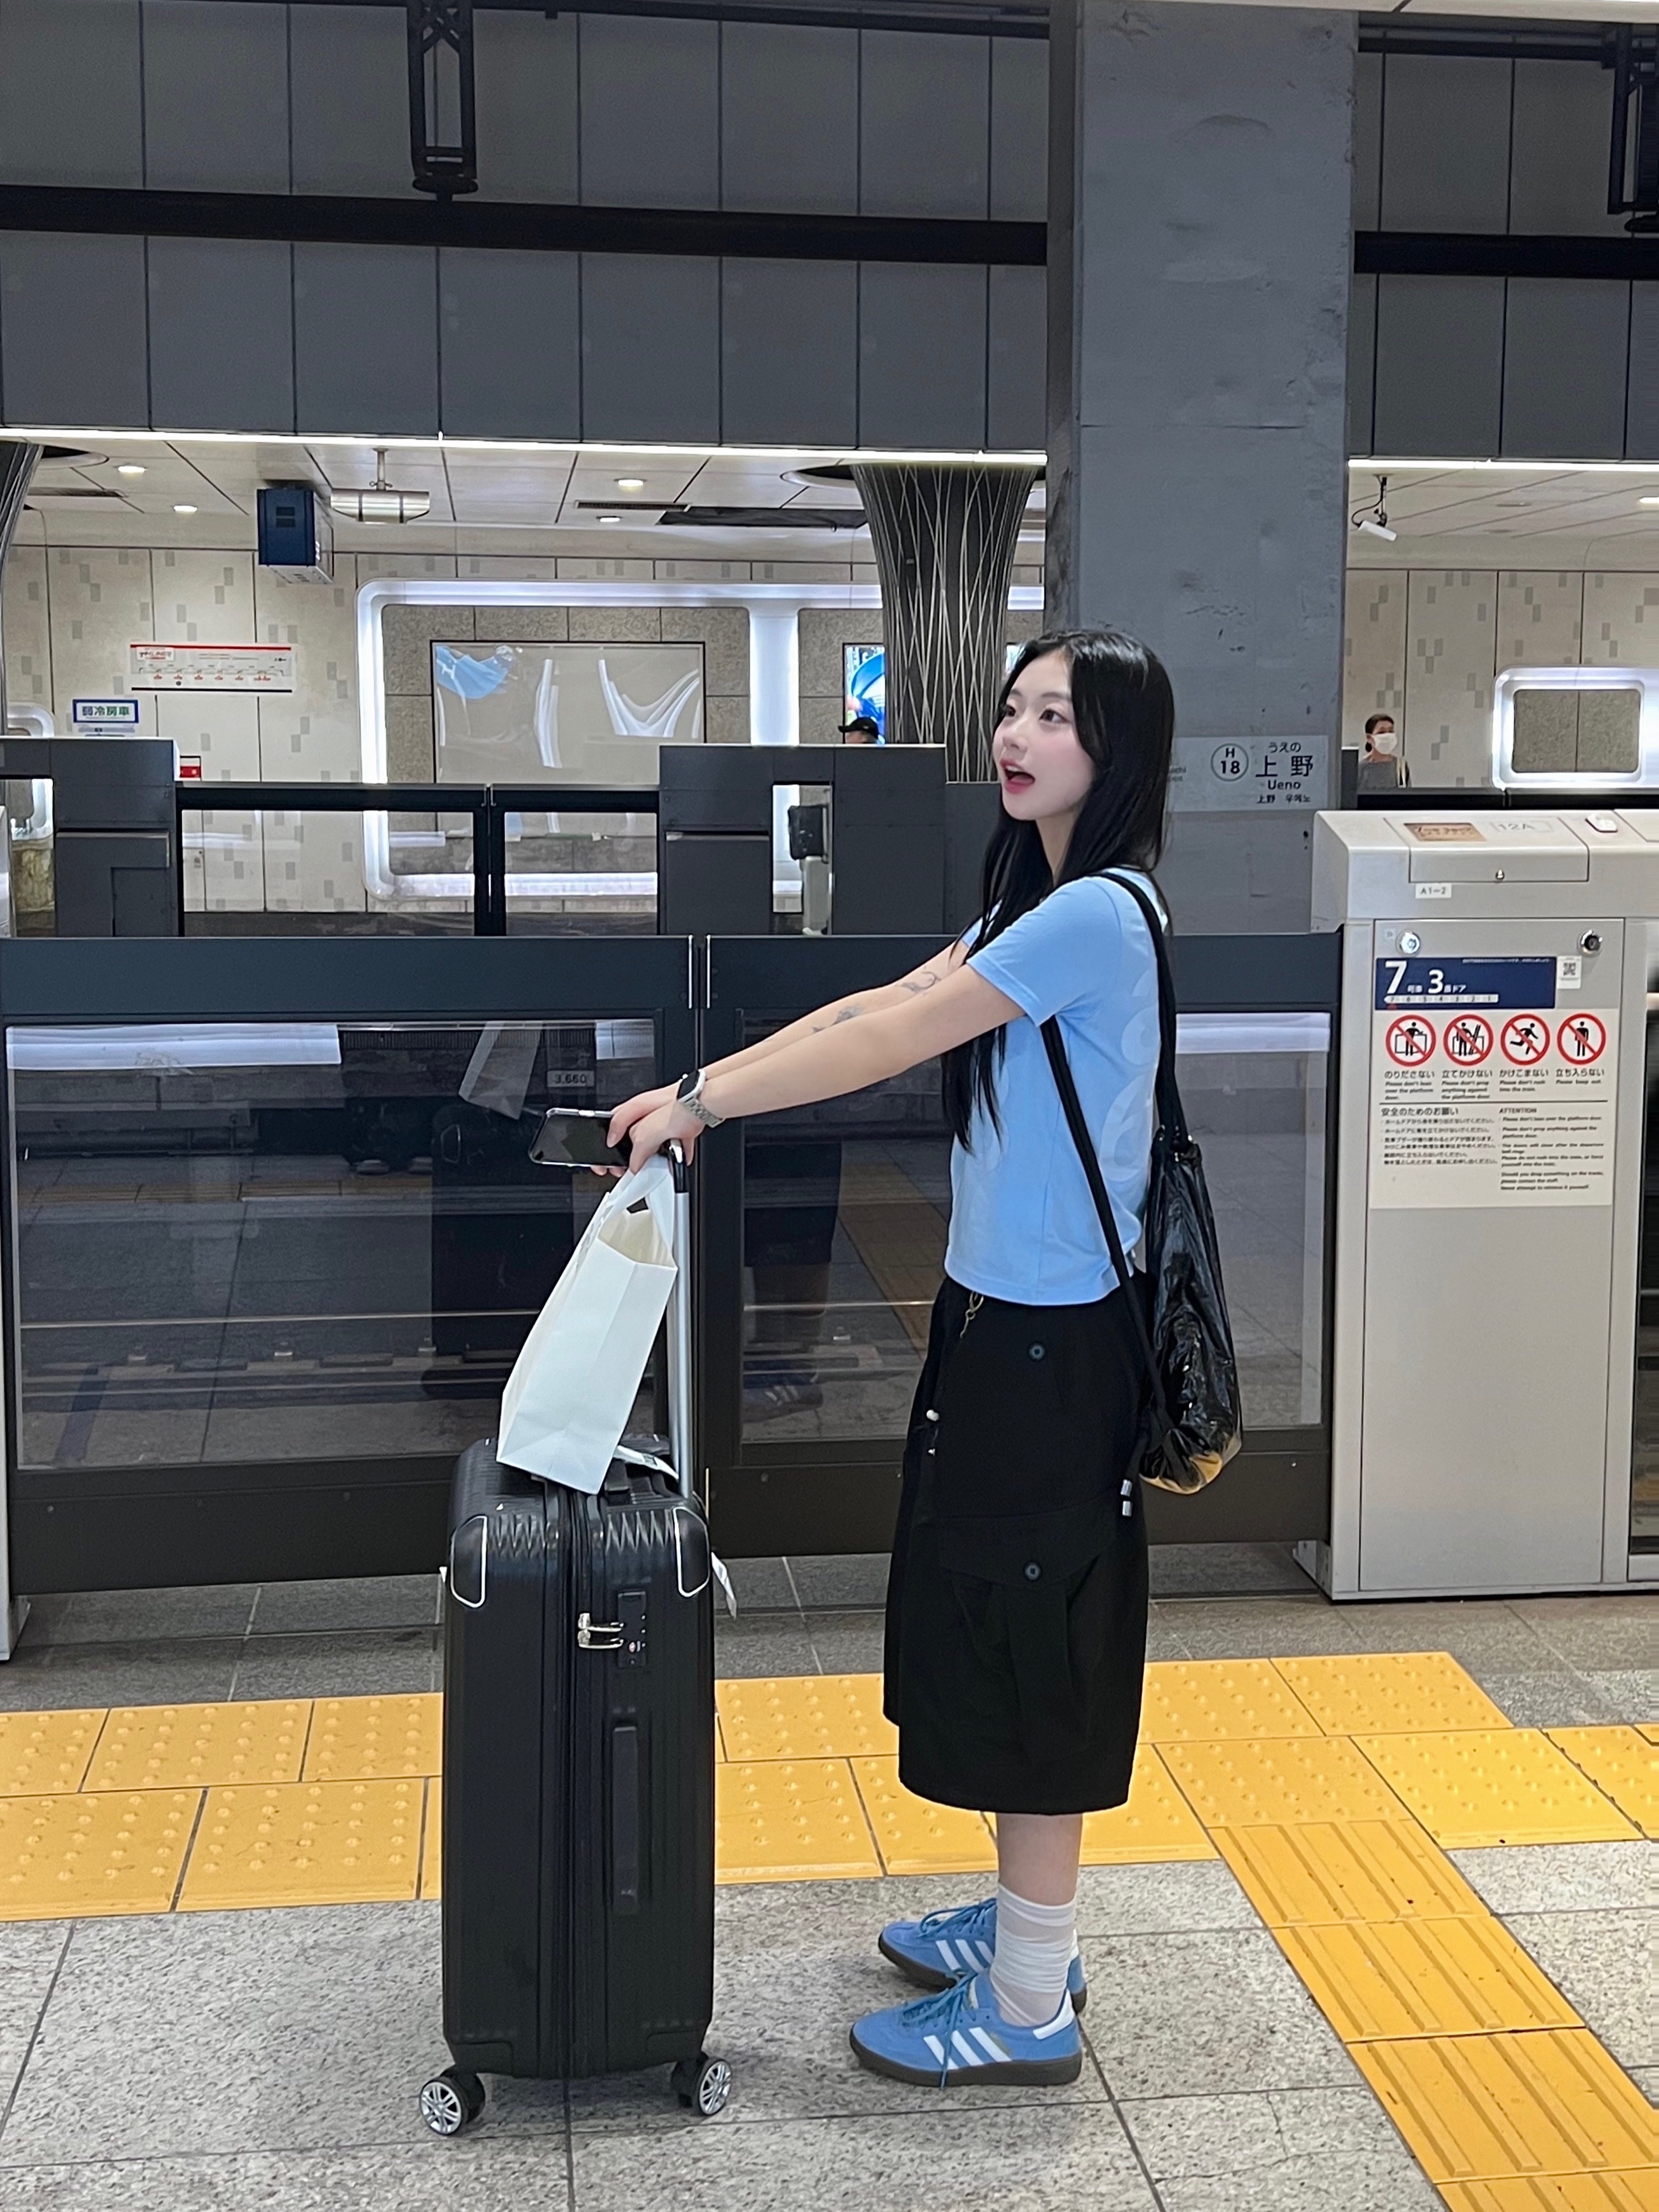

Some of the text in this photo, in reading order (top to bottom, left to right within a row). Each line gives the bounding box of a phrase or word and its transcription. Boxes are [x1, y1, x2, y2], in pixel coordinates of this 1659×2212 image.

[1269, 742, 1301, 753] うえの
[1226, 748, 1235, 758] H
[1221, 761, 1240, 774] 18
[1256, 755, 1313, 777] 上野
[1268, 779, 1301, 790] Ueno
[1384, 1070, 1435, 1079] のりださない
[1442, 1069, 1493, 1078] 立てかけない
[1499, 1069, 1549, 1078] かけこまない
[1556, 1068, 1605, 1077] 立ち入らない
